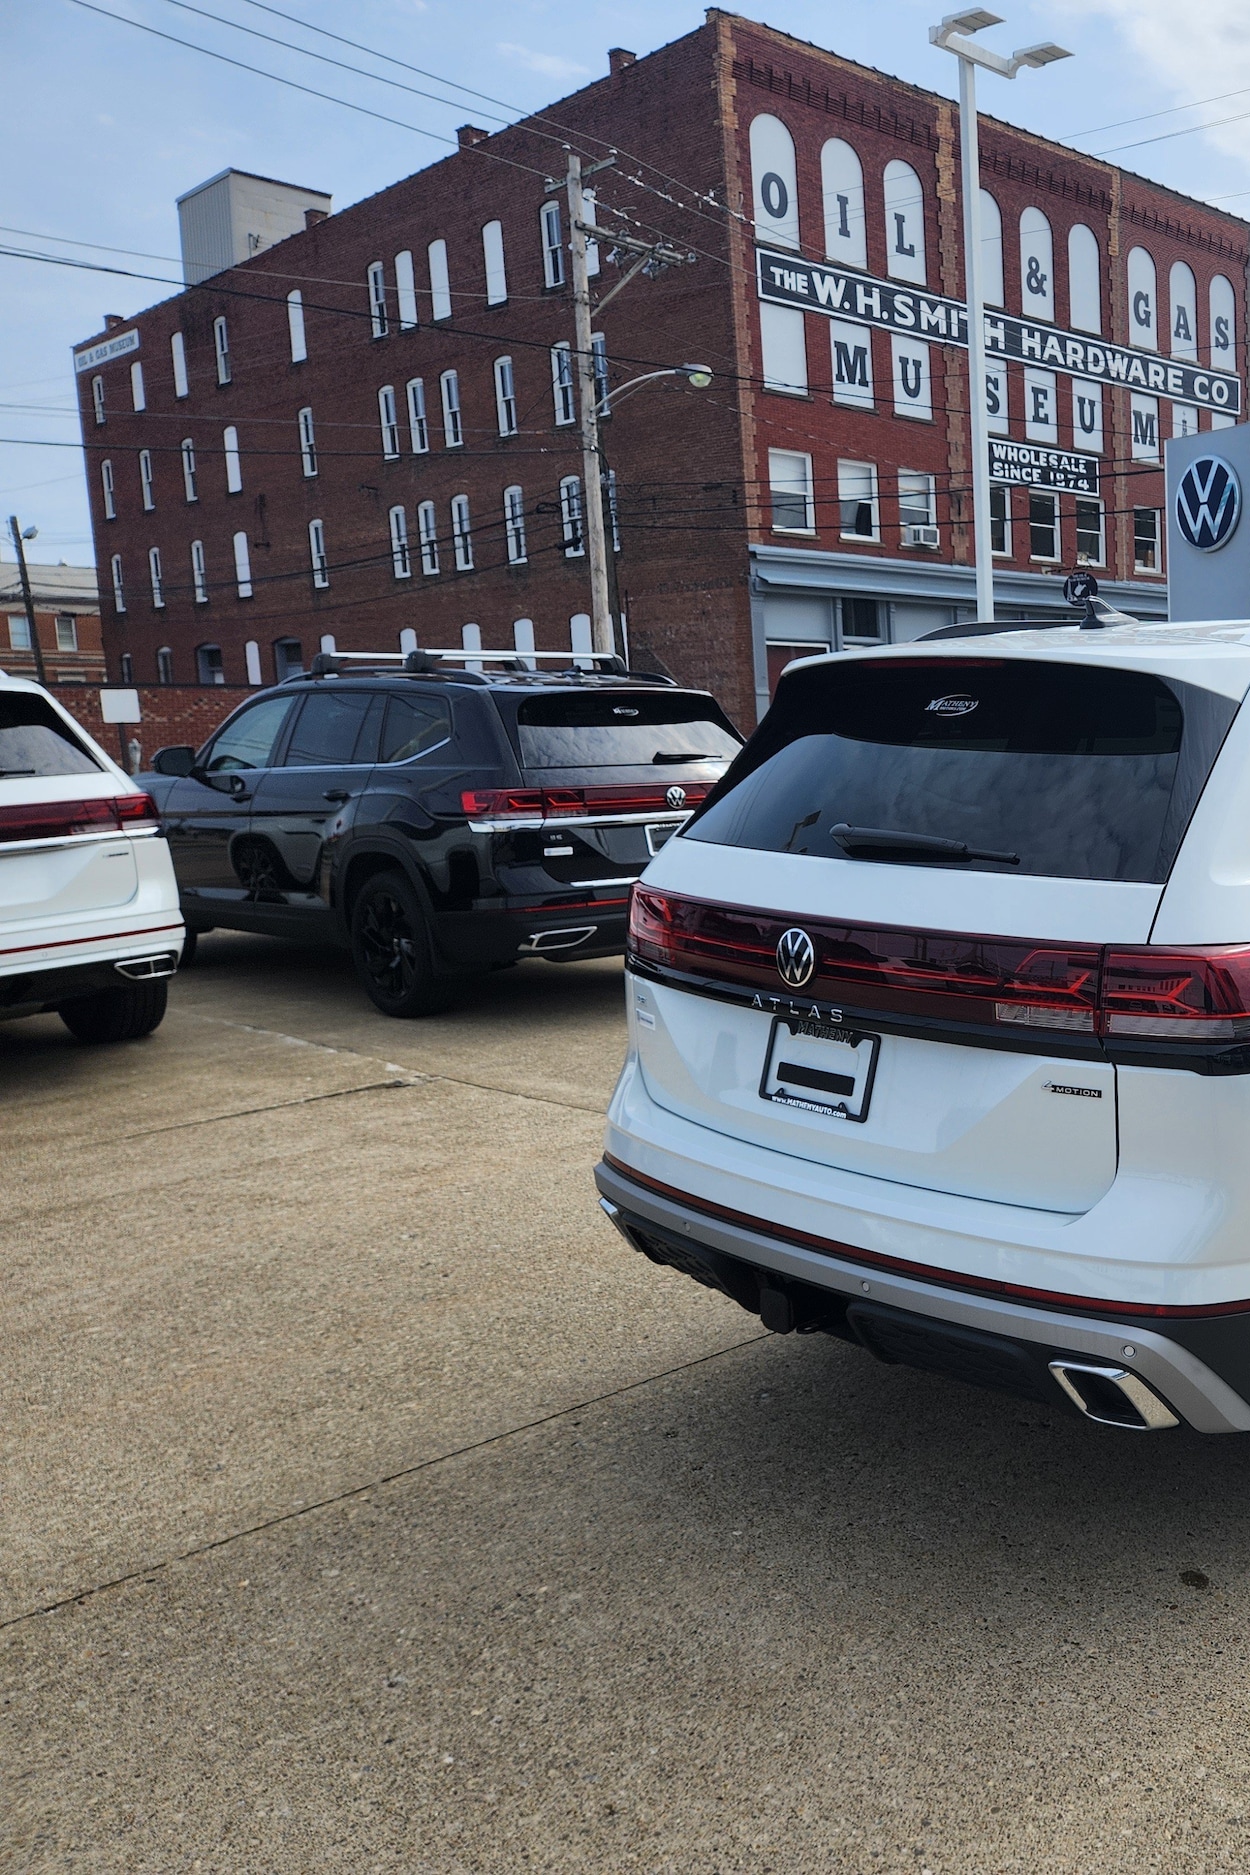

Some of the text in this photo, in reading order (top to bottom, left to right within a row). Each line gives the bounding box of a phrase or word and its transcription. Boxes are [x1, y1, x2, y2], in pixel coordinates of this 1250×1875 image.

[761, 172, 1229, 350] OIL & GAS
[770, 266, 809, 295] THE
[1021, 328, 1184, 395] HARDWARE
[1193, 375, 1230, 405] CO
[992, 443, 1087, 474] WHOLESALE
[993, 461, 1042, 483] SINCE
[752, 994, 843, 1022] ATLAS
[798, 1020, 853, 1044] MATHENY
